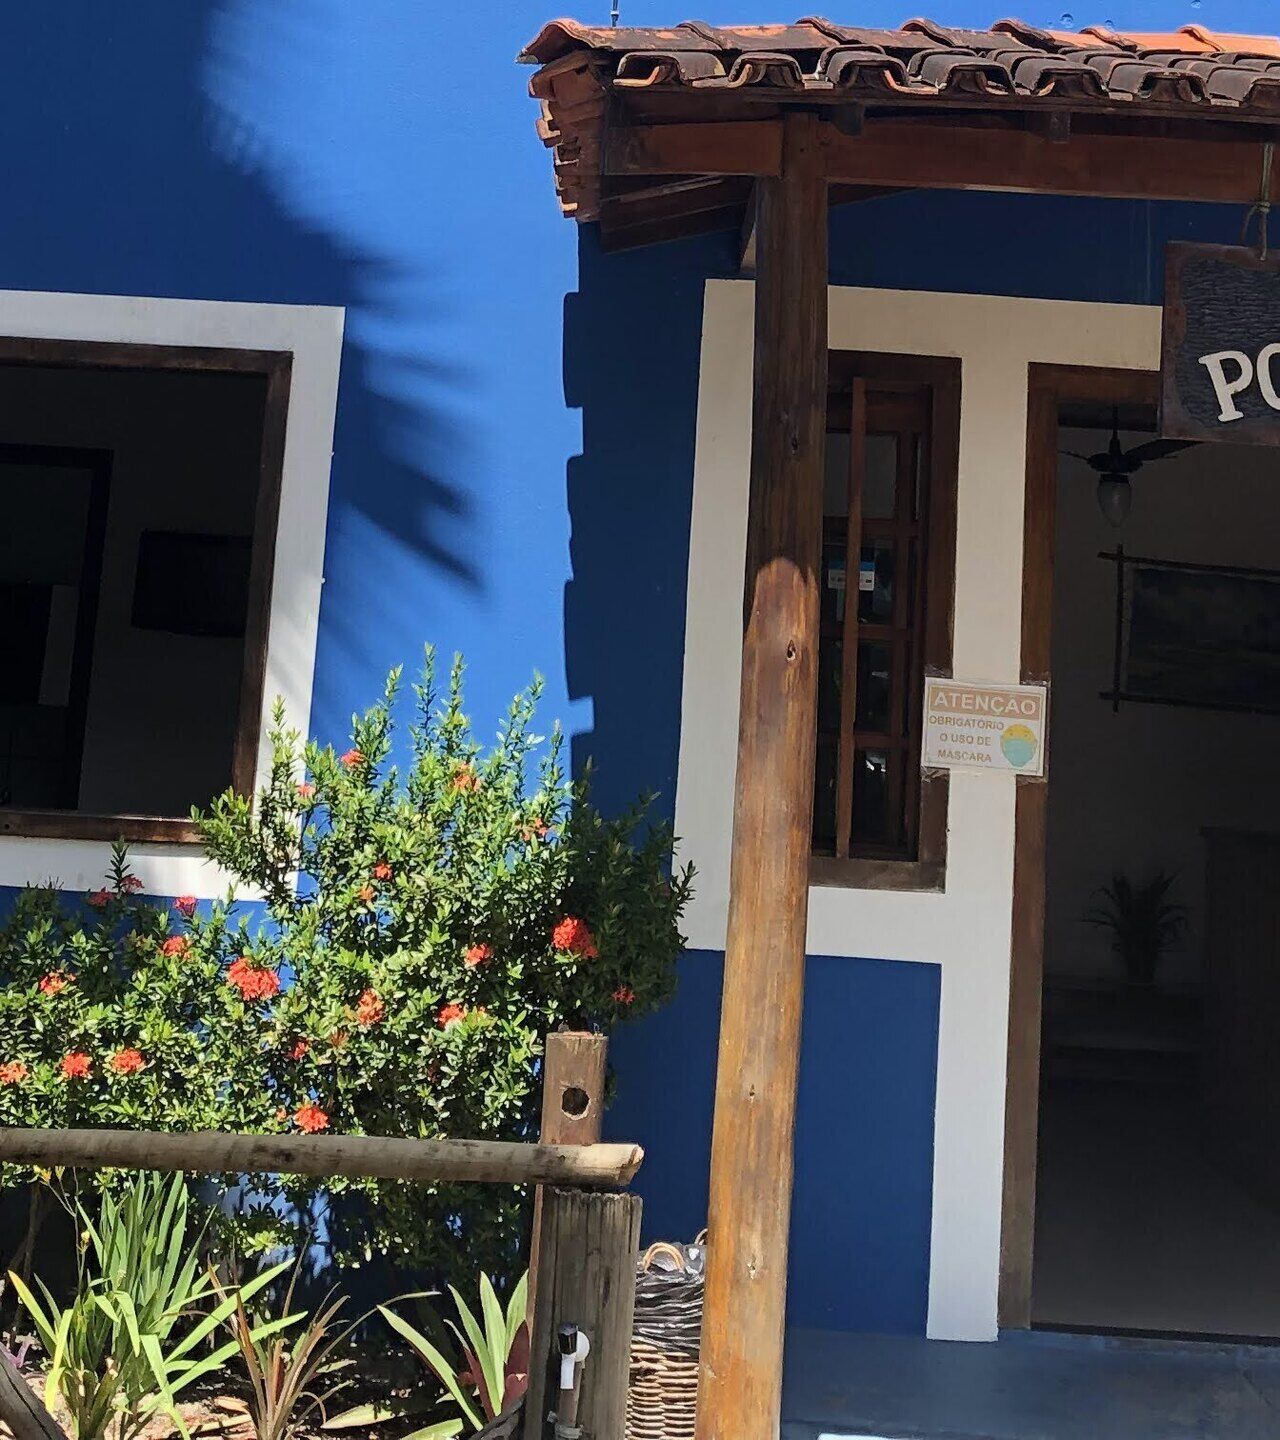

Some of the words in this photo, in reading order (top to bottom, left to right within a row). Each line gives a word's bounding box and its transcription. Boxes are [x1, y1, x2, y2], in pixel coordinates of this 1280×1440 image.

[933, 691, 1036, 715] ATENÇÃO
[929, 715, 1004, 731] OBRIGATÓRIO
[939, 733, 948, 742] O
[951, 734, 974, 745] USO
[976, 736, 992, 747] DE
